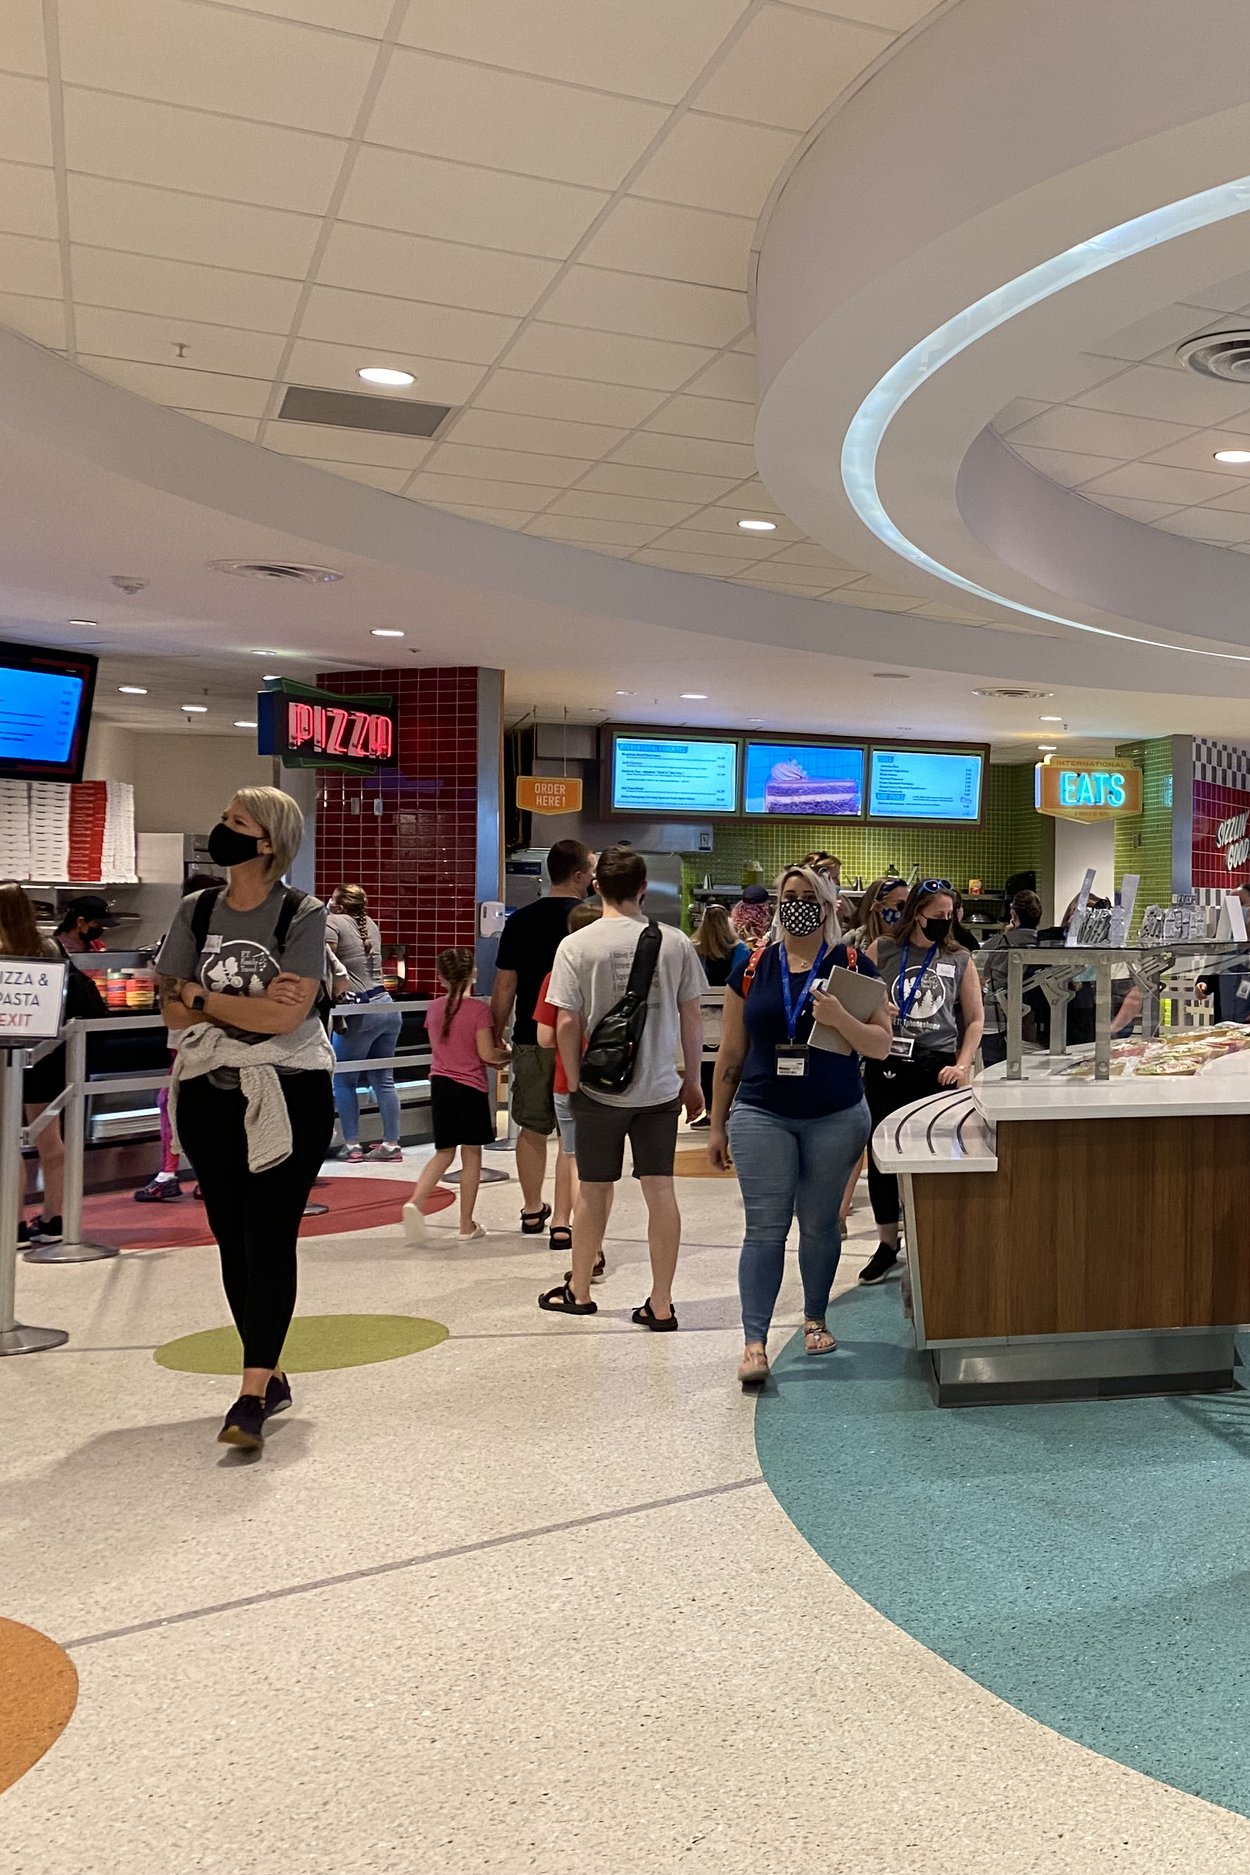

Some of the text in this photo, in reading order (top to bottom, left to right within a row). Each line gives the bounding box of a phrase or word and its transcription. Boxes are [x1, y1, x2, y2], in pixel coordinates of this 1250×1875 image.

[288, 701, 393, 760] PIZZA
[1056, 760, 1127, 768] INTERNATIONAL
[534, 783, 566, 795] ORDER
[1060, 771, 1125, 807] EATS
[0, 971, 49, 987] IZZA &
[0, 1012, 33, 1027] EXIT
